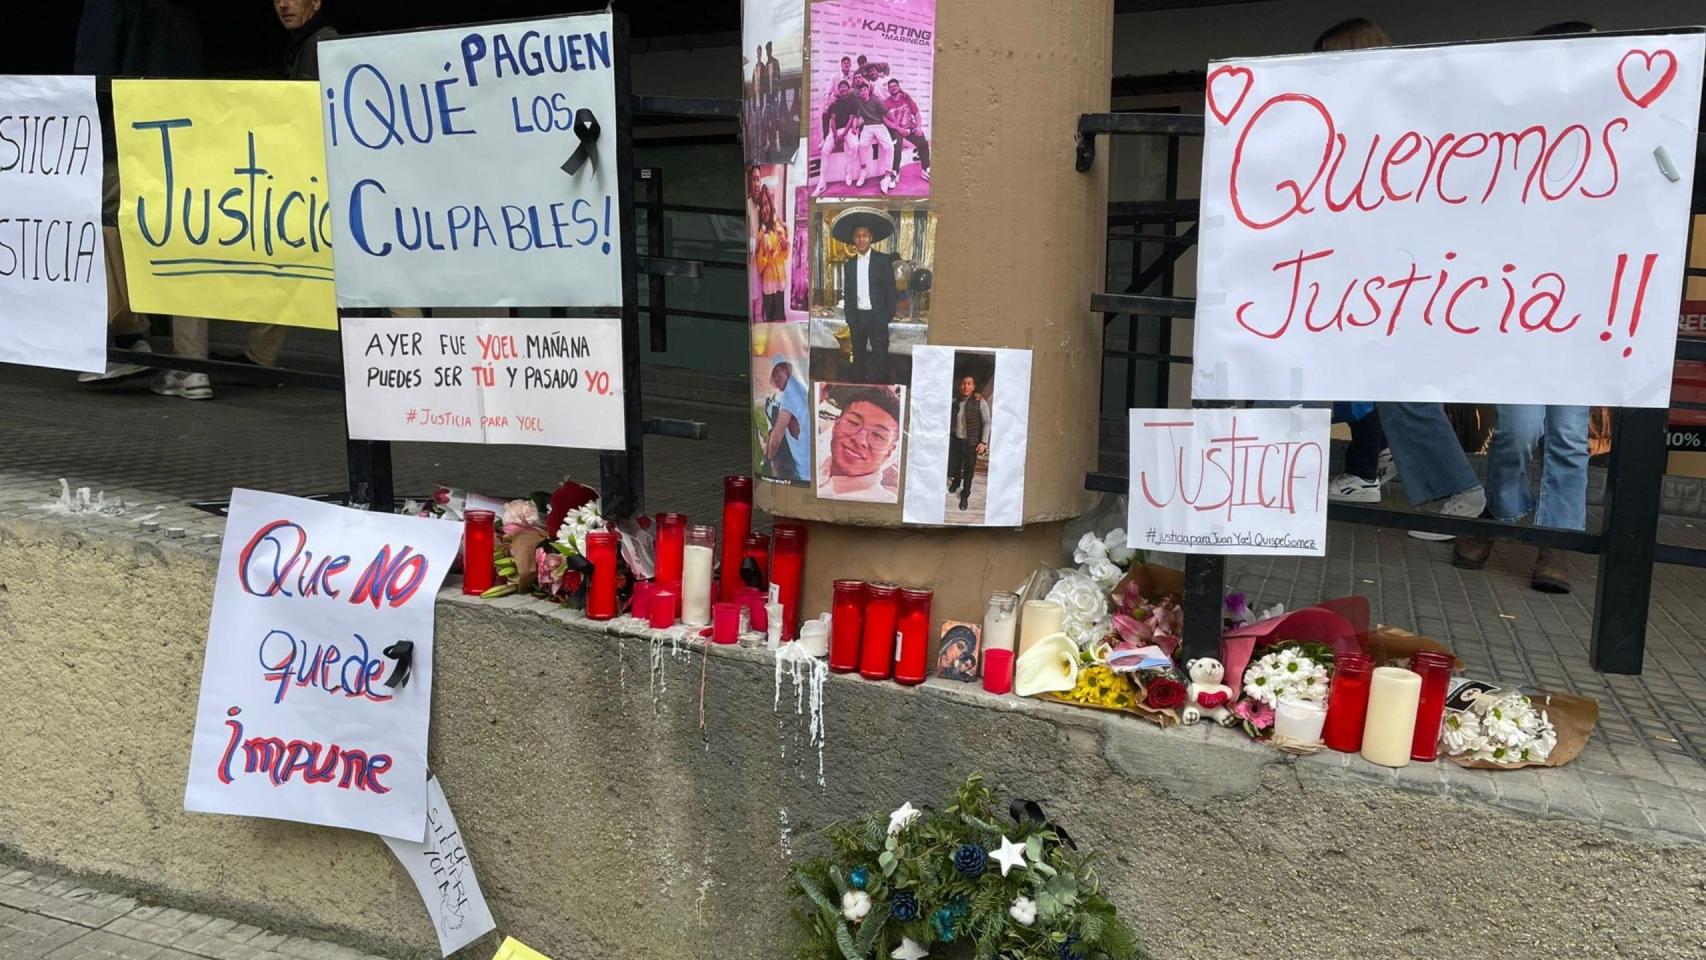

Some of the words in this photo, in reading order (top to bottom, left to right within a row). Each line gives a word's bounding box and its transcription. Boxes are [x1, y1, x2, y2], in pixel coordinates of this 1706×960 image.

[862, 19, 931, 40] KARTING
[461, 31, 611, 87] PAGUEN
[327, 62, 477, 150] ¡QUÉ
[512, 93, 573, 133] LOS
[1230, 93, 1628, 230] Queremos
[349, 178, 611, 257] CULPABLES!
[365, 332, 422, 356] AYER
[440, 335, 467, 355] FUE
[526, 331, 591, 359] MAÑANA
[367, 366, 422, 388] PUEDES
[434, 366, 462, 388] SER
[471, 362, 495, 387] TÚ
[506, 367, 518, 388] Y
[525, 367, 578, 389] PASADO
[585, 370, 614, 396] YO.
[480, 416, 509, 427] PARA
[516, 416, 543, 432] YOEL
[1665, 432, 1700, 447] 10%
[1141, 416, 1323, 522] JUSTICIA
[239, 519, 351, 598] Que
[349, 543, 429, 609] NO
